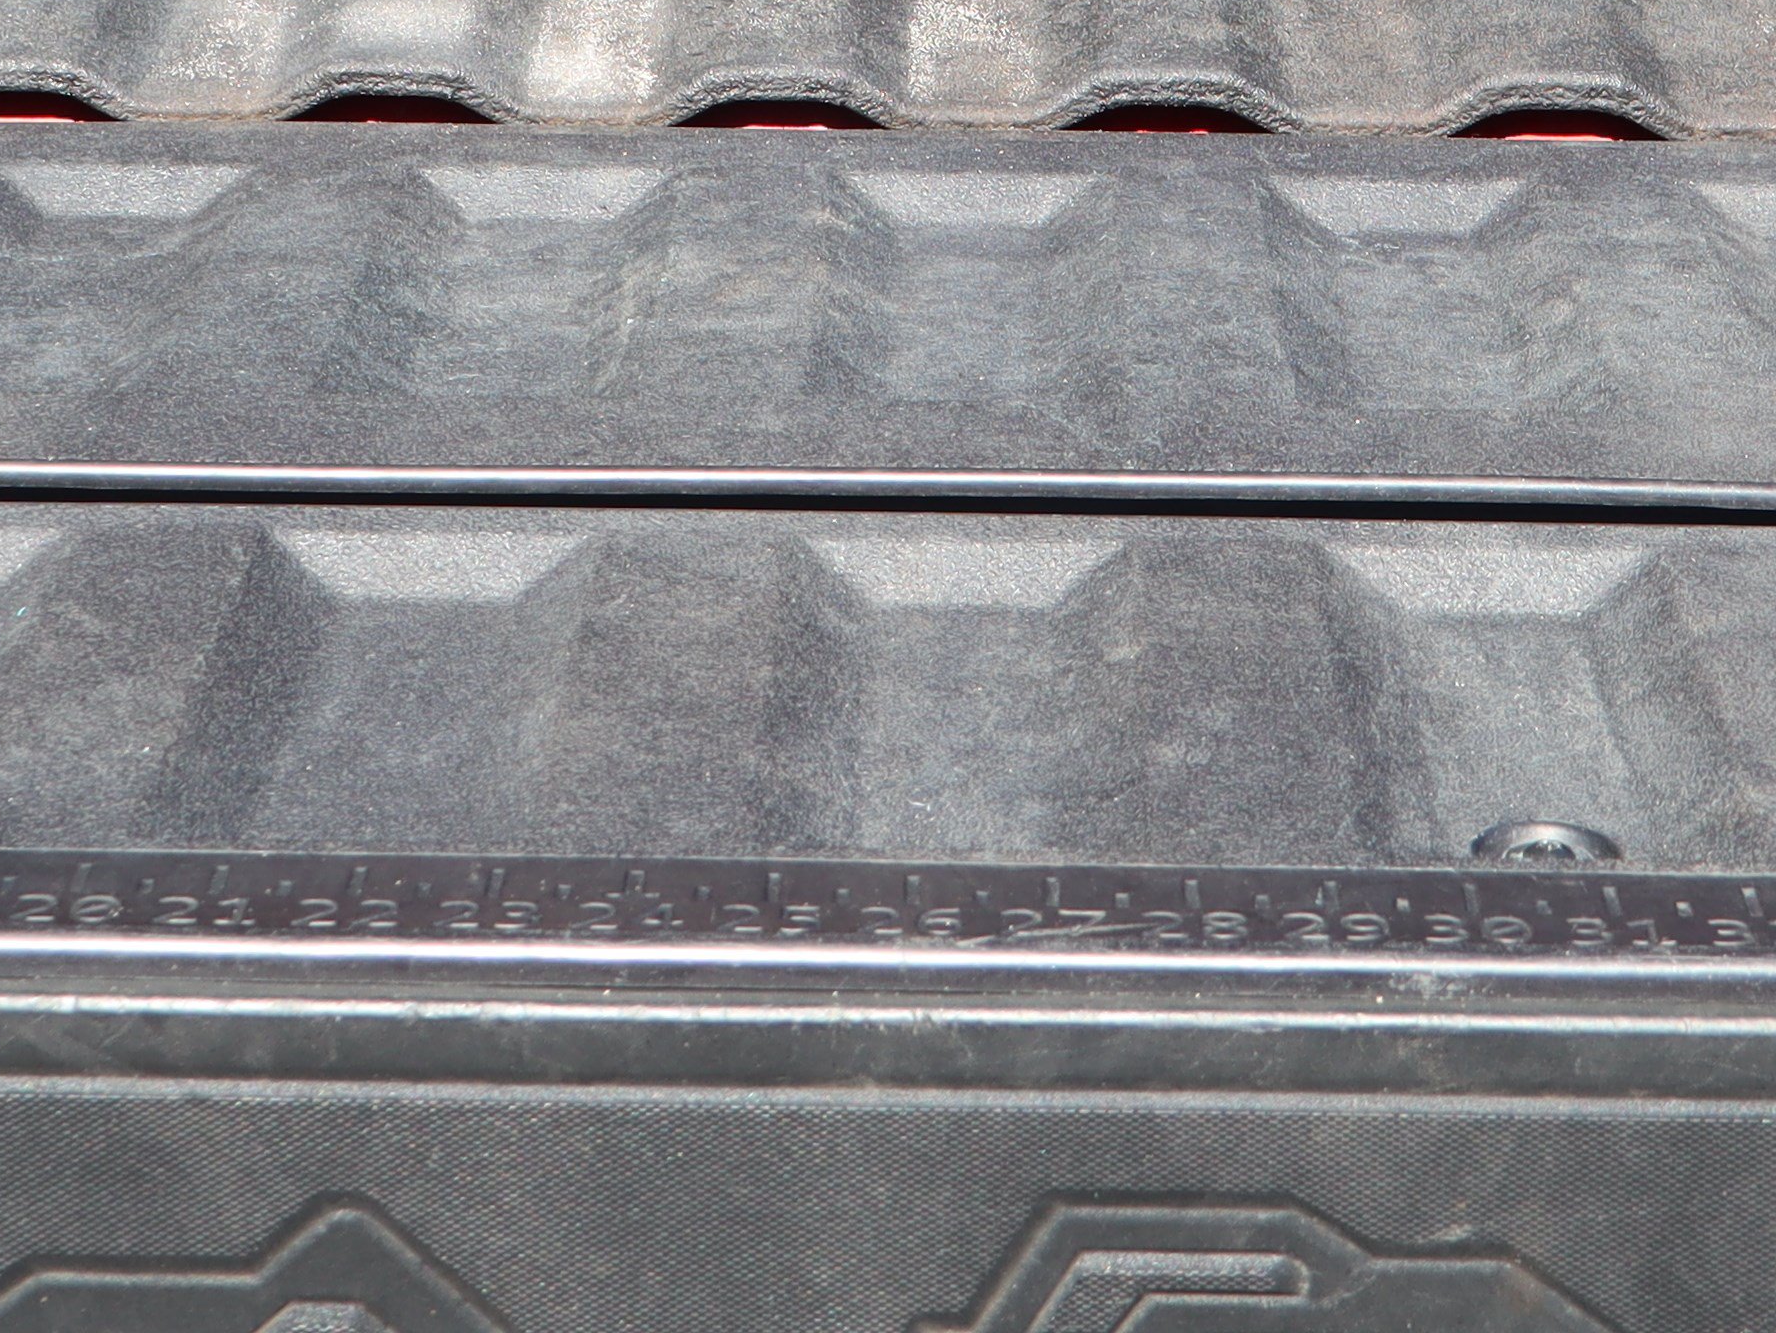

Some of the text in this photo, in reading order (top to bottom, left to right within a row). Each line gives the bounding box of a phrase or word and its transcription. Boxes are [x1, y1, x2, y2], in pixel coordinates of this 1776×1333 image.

[10, 894, 122, 923] 20
[152, 896, 255, 925] 21
[290, 898, 399, 928] 22
[433, 900, 539, 929] 23
[571, 902, 684, 930] 24
[718, 905, 821, 936] 25
[857, 906, 963, 936] 26
[1001, 909, 1108, 938] 27
[1141, 911, 1249, 940] 28
[1280, 912, 1389, 943] 29
[1424, 914, 1532, 945] 30
[1566, 916, 1678, 947] 31
